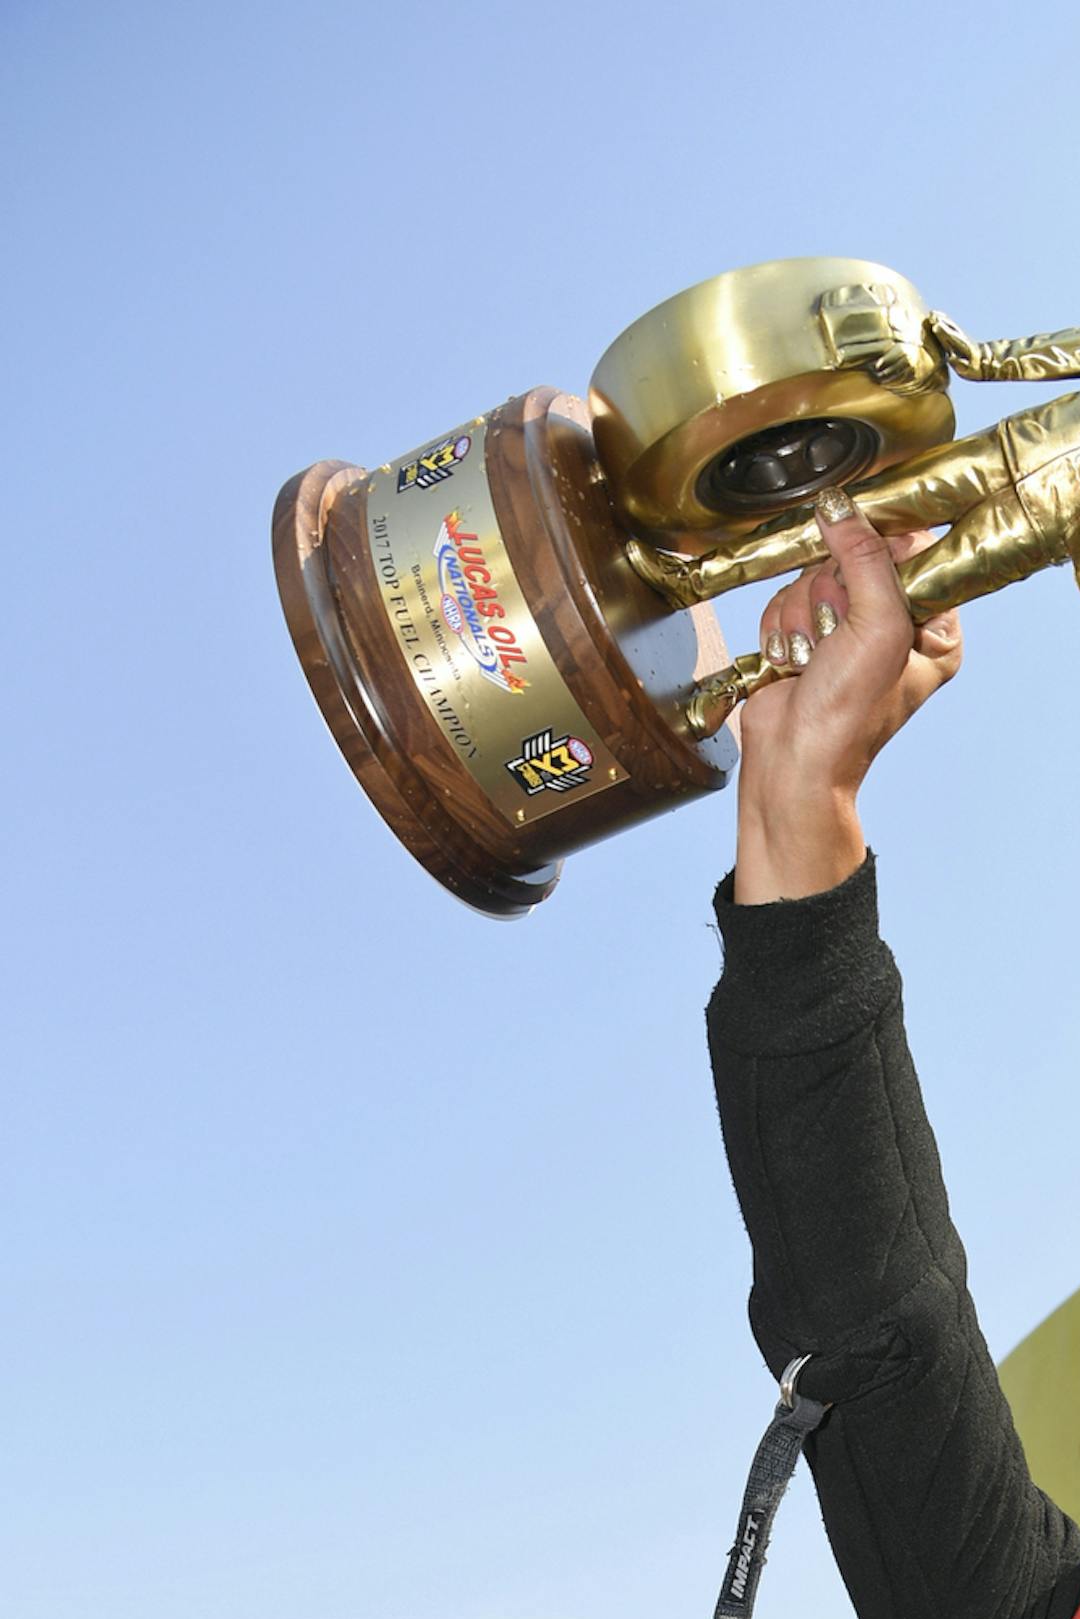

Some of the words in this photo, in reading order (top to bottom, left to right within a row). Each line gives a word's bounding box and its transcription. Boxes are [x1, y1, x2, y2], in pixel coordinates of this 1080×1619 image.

[372, 515, 391, 549] 2017
[379, 553, 400, 591] TOP
[443, 555, 495, 658] NATIONALS
[450, 532, 506, 619] LUCAS
[487, 625, 528, 669] OIL
[390, 596, 422, 651] FUEL
[729, 1514, 761, 1599] IMPACT
